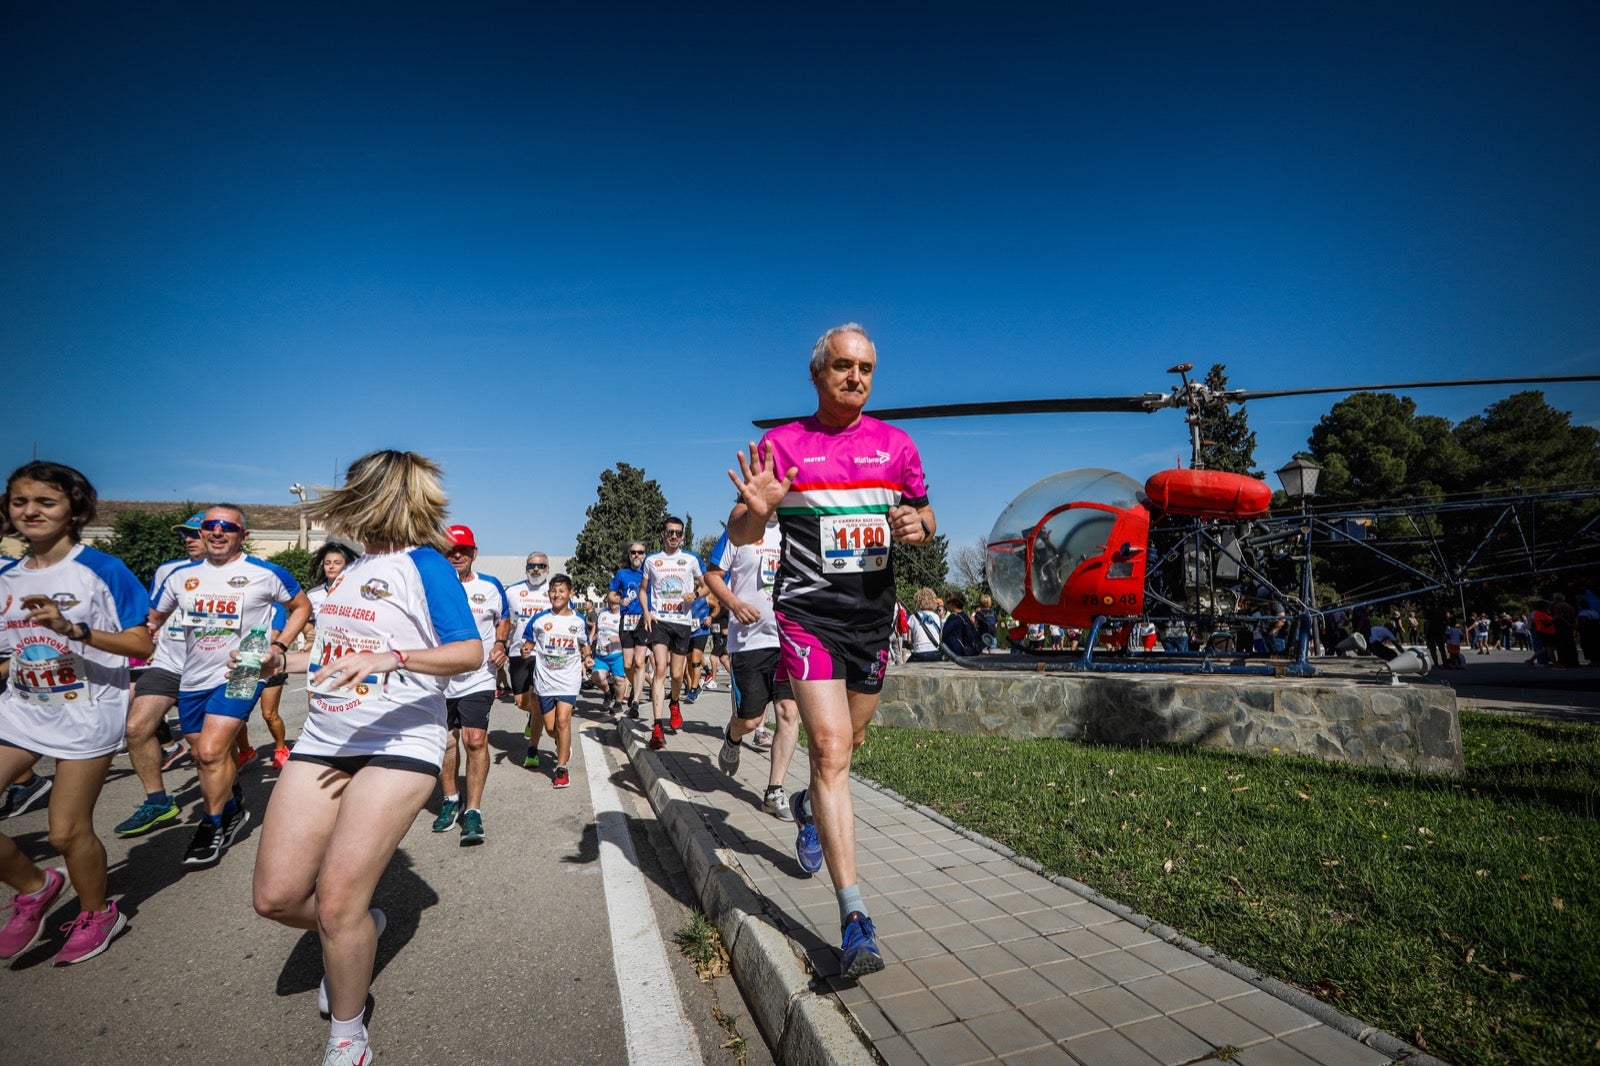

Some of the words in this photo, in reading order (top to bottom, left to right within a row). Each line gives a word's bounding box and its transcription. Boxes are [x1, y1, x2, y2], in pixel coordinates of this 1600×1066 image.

[835, 526, 885, 549] 1180
[196, 599, 237, 614] 1156
[1120, 593, 1137, 605] 48
[338, 605, 353, 618] BASE
[351, 607, 376, 622] AEREA
[550, 637, 574, 648] 1172
[16, 667, 77, 688] 1118
[328, 704, 344, 713] MAYO
[345, 698, 362, 711] 2022
